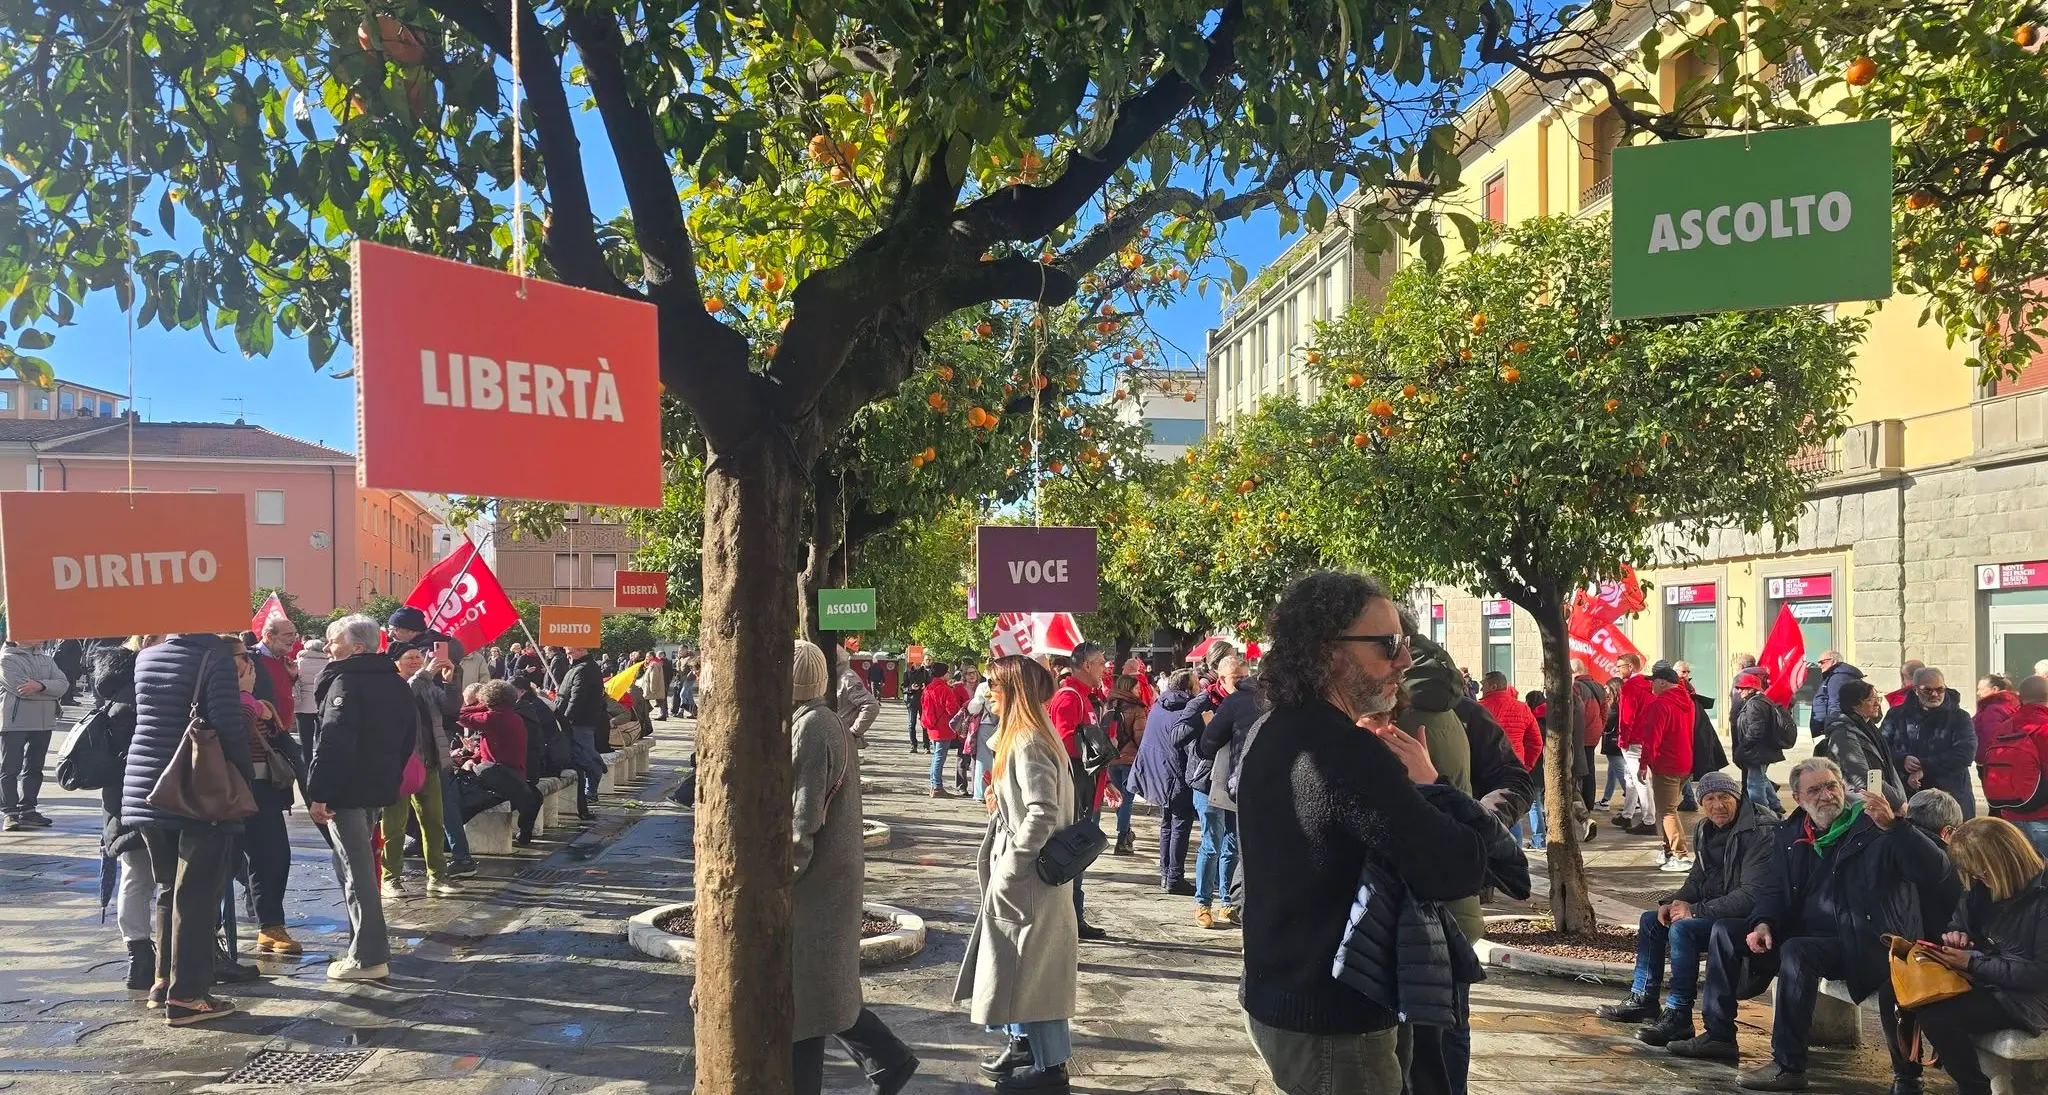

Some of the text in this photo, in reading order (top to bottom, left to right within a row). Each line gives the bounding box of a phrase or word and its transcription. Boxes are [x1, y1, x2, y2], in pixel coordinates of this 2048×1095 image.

[1648, 191, 1852, 254] ASCOLTO
[421, 350, 623, 422] LIBERTÀ
[53, 551, 216, 589] DIRITTO
[1008, 559, 1068, 584] VOCE
[622, 583, 658, 595] LIBERTÀ
[826, 602, 868, 615] ASCOLTO
[549, 623, 591, 634] DIRITTO
